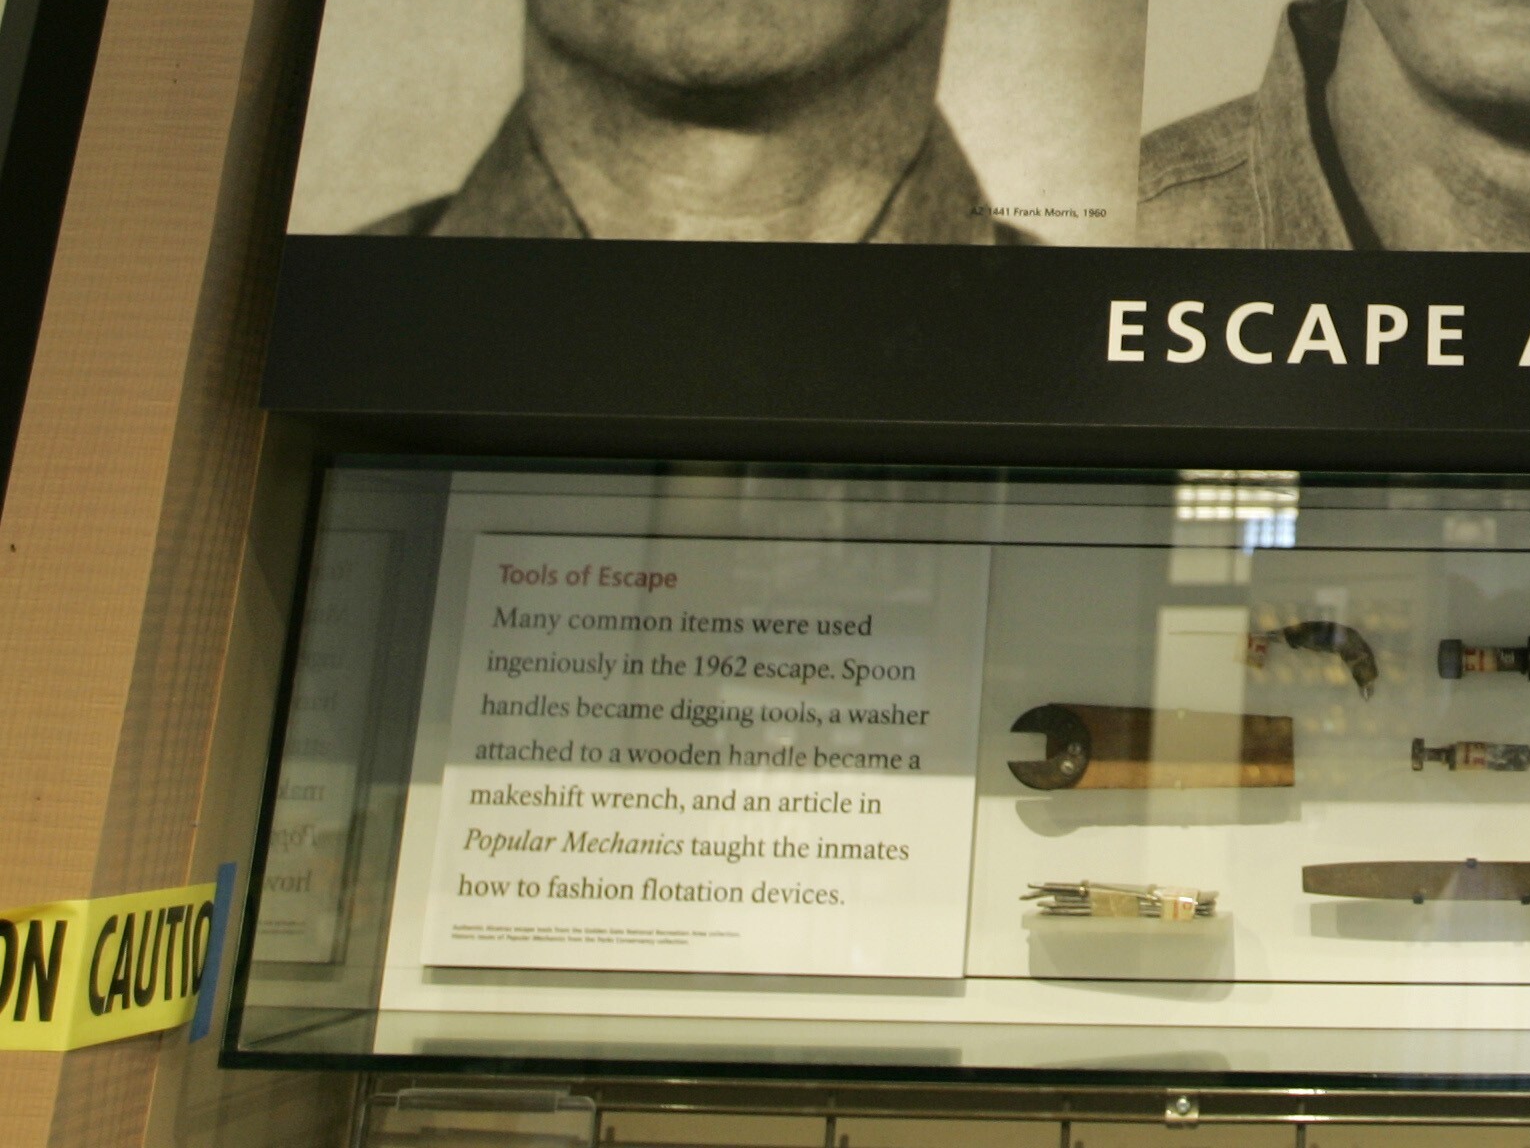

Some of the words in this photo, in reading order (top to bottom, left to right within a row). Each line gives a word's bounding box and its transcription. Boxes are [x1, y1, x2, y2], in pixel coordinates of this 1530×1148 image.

[1013, 208, 1041, 217] Frank
[1107, 300, 1465, 366] ESCAPE
[499, 563, 558, 586] Tools
[565, 563, 592, 587] of
[599, 566, 678, 592] Escape
[491, 606, 561, 635] Many
[568, 612, 673, 631] common
[680, 611, 744, 633] items
[752, 616, 809, 635] were
[817, 614, 873, 636] used
[486, 650, 617, 680] ingeniously
[622, 654, 644, 675] in
[651, 654, 686, 676] the
[694, 654, 747, 678] 1962
[753, 661, 835, 685] escape.
[841, 658, 916, 686] Spoon
[481, 693, 570, 718] handles
[576, 696, 664, 720] became
[671, 698, 754, 728] digging
[761, 701, 823, 726] tools,
[829, 707, 841, 724] a
[848, 703, 930, 726] washer
[474, 740, 574, 762] attached
[580, 745, 603, 762] to
[608, 747, 621, 764] a
[627, 743, 721, 766] wooden
[728, 744, 807, 767] handle
[813, 746, 902, 770] became
[908, 753, 921, 770] a
[469, 783, 584, 808] makeshift
[591, 788, 686, 814] wrench,
[692, 789, 736, 811] and
[743, 795, 771, 813] an
[778, 791, 853, 814] article
[858, 792, 882, 815] in
[462, 828, 557, 858] Popular
[561, 831, 685, 856] Mechanics
[691, 835, 766, 865] taught
[772, 836, 809, 859] the
[816, 837, 909, 861] inmates
[457, 873, 511, 898] how
[517, 879, 541, 898] to
[547, 875, 634, 901] fashion
[641, 877, 743, 903] flotation
[751, 881, 845, 906] devices.
